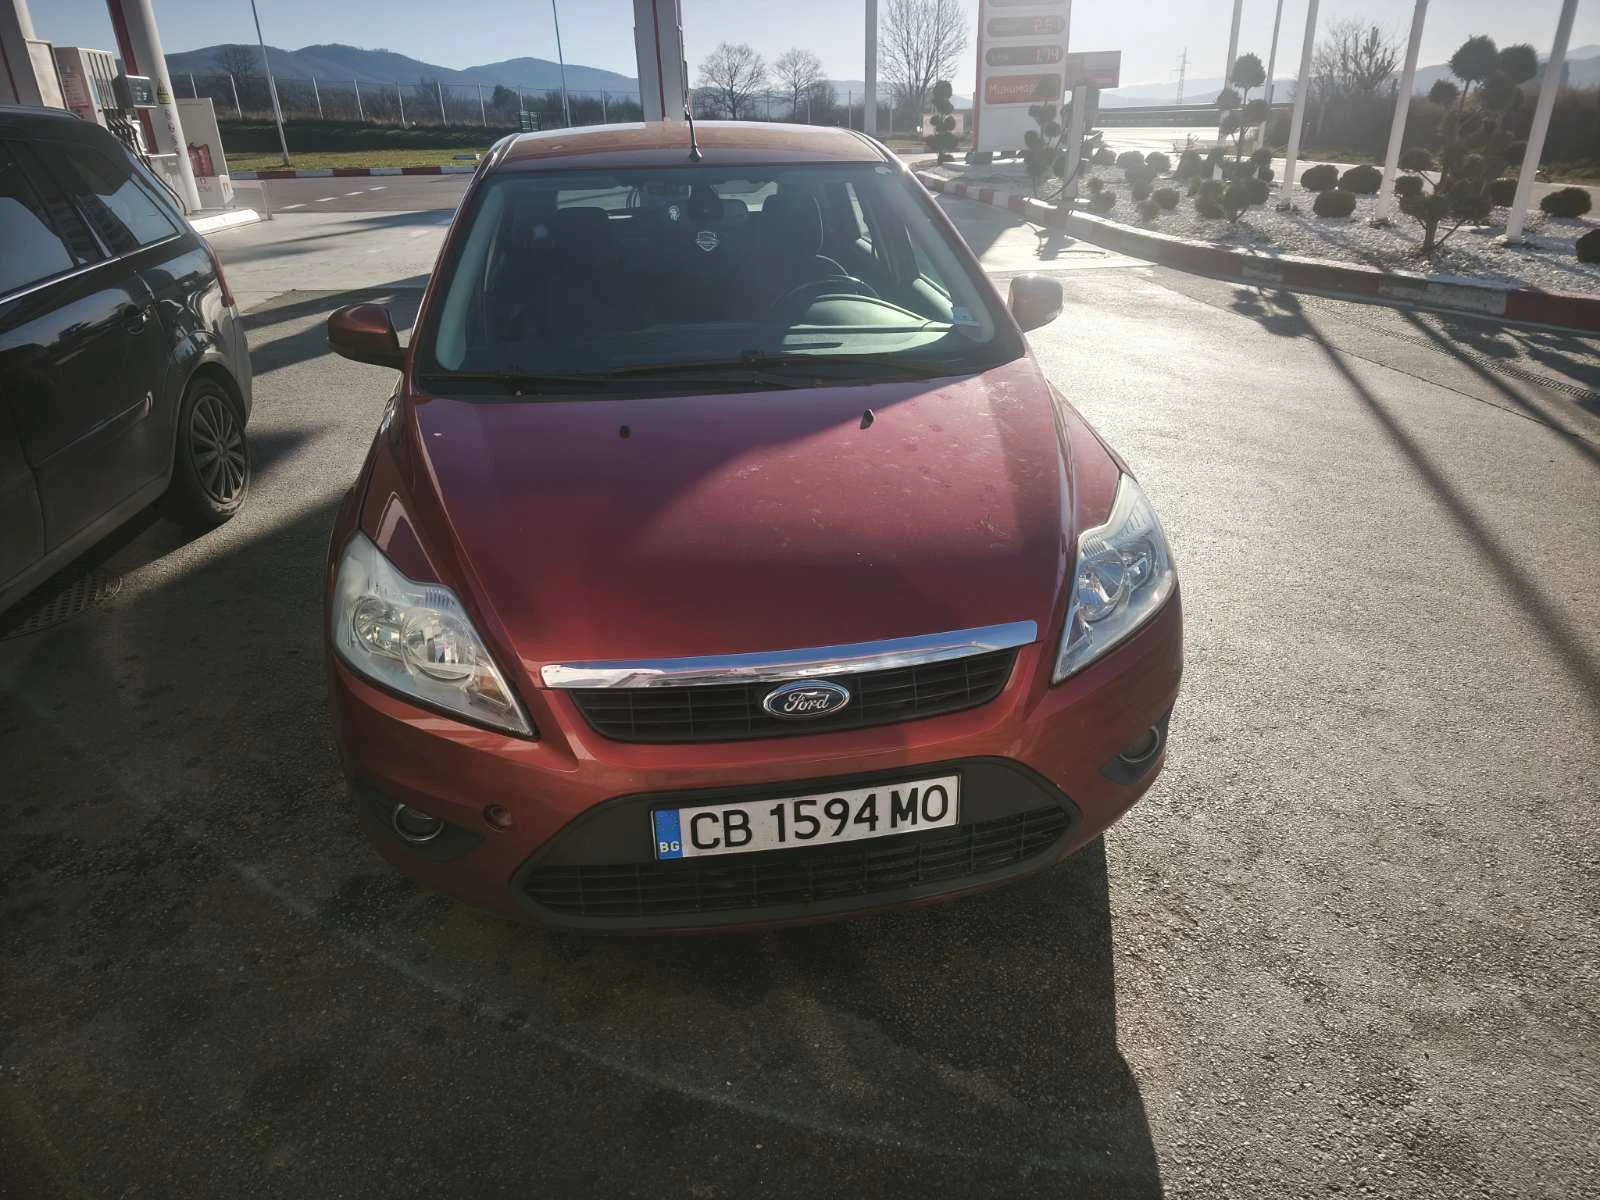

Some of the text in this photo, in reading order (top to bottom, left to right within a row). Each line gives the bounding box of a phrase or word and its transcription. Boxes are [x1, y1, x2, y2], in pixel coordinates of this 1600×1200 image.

[783, 691, 830, 712] Ford
[689, 784, 949, 850] CB 1594 MO
[659, 841, 680, 853] BG
